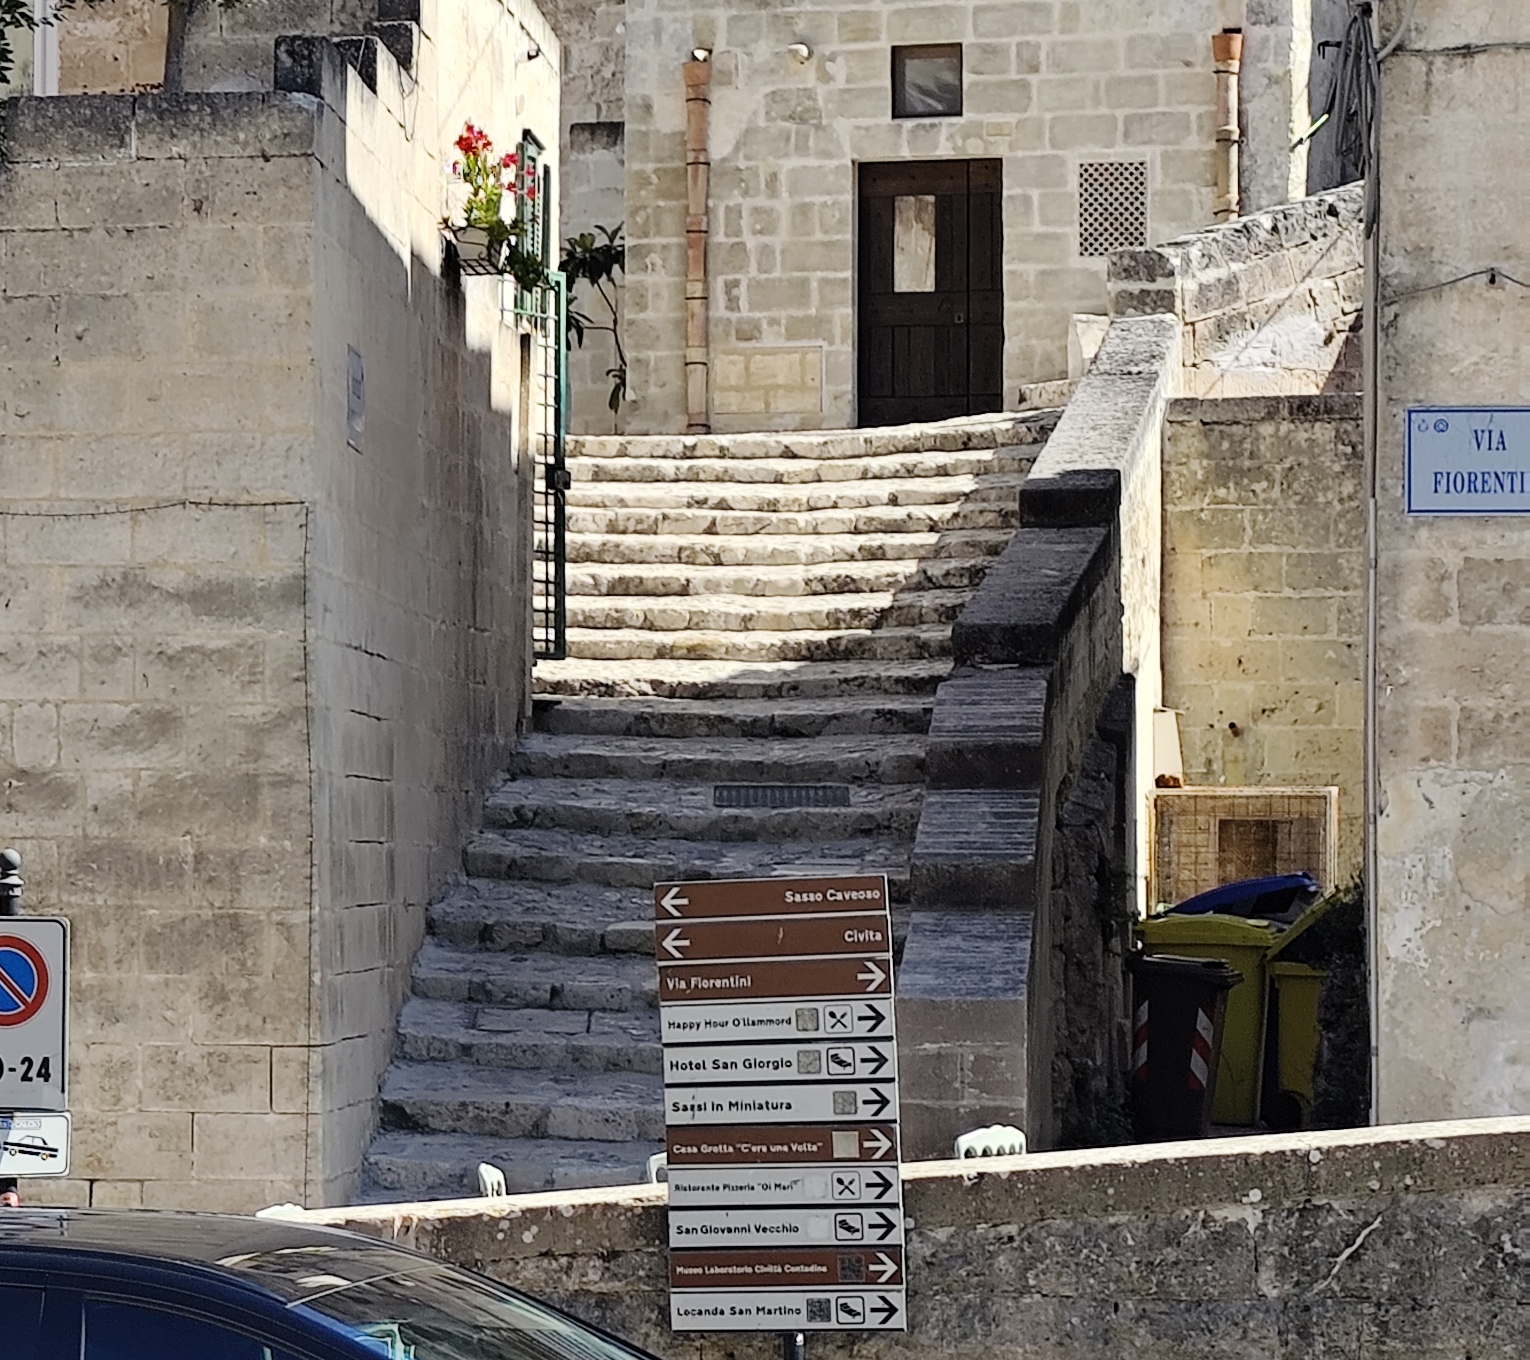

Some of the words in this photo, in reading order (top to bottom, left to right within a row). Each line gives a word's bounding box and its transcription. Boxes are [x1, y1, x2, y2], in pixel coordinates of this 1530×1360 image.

[1473, 428, 1507, 451] VIA
[1433, 470, 1525, 494] FIORENTI
[784, 891, 823, 904] Sasso
[826, 888, 881, 902] Caveoso
[844, 929, 883, 943] Civita
[666, 977, 687, 990] Via
[690, 975, 752, 990] Fiorentini
[668, 1019, 701, 1032] Happy
[705, 1018, 729, 1029] Hour
[670, 1058, 708, 1072] Hotel
[711, 1059, 738, 1070] San
[742, 1057, 794, 1071] Giorgio
[671, 1101, 708, 1113] Sassi
[711, 1101, 724, 1112] in
[728, 1099, 793, 1112] Miniatura
[672, 1143, 699, 1154] Casa
[700, 1143, 734, 1154] Grotta
[674, 1183, 720, 1192] Ristorante
[722, 1182, 755, 1192] Pizzeria
[675, 1225, 699, 1236] San
[700, 1223, 751, 1235] Giovanni
[754, 1223, 800, 1234] Vecchio
[677, 1306, 725, 1318] Locanda
[729, 1305, 752, 1316] San
[756, 1304, 802, 1316] Martino
